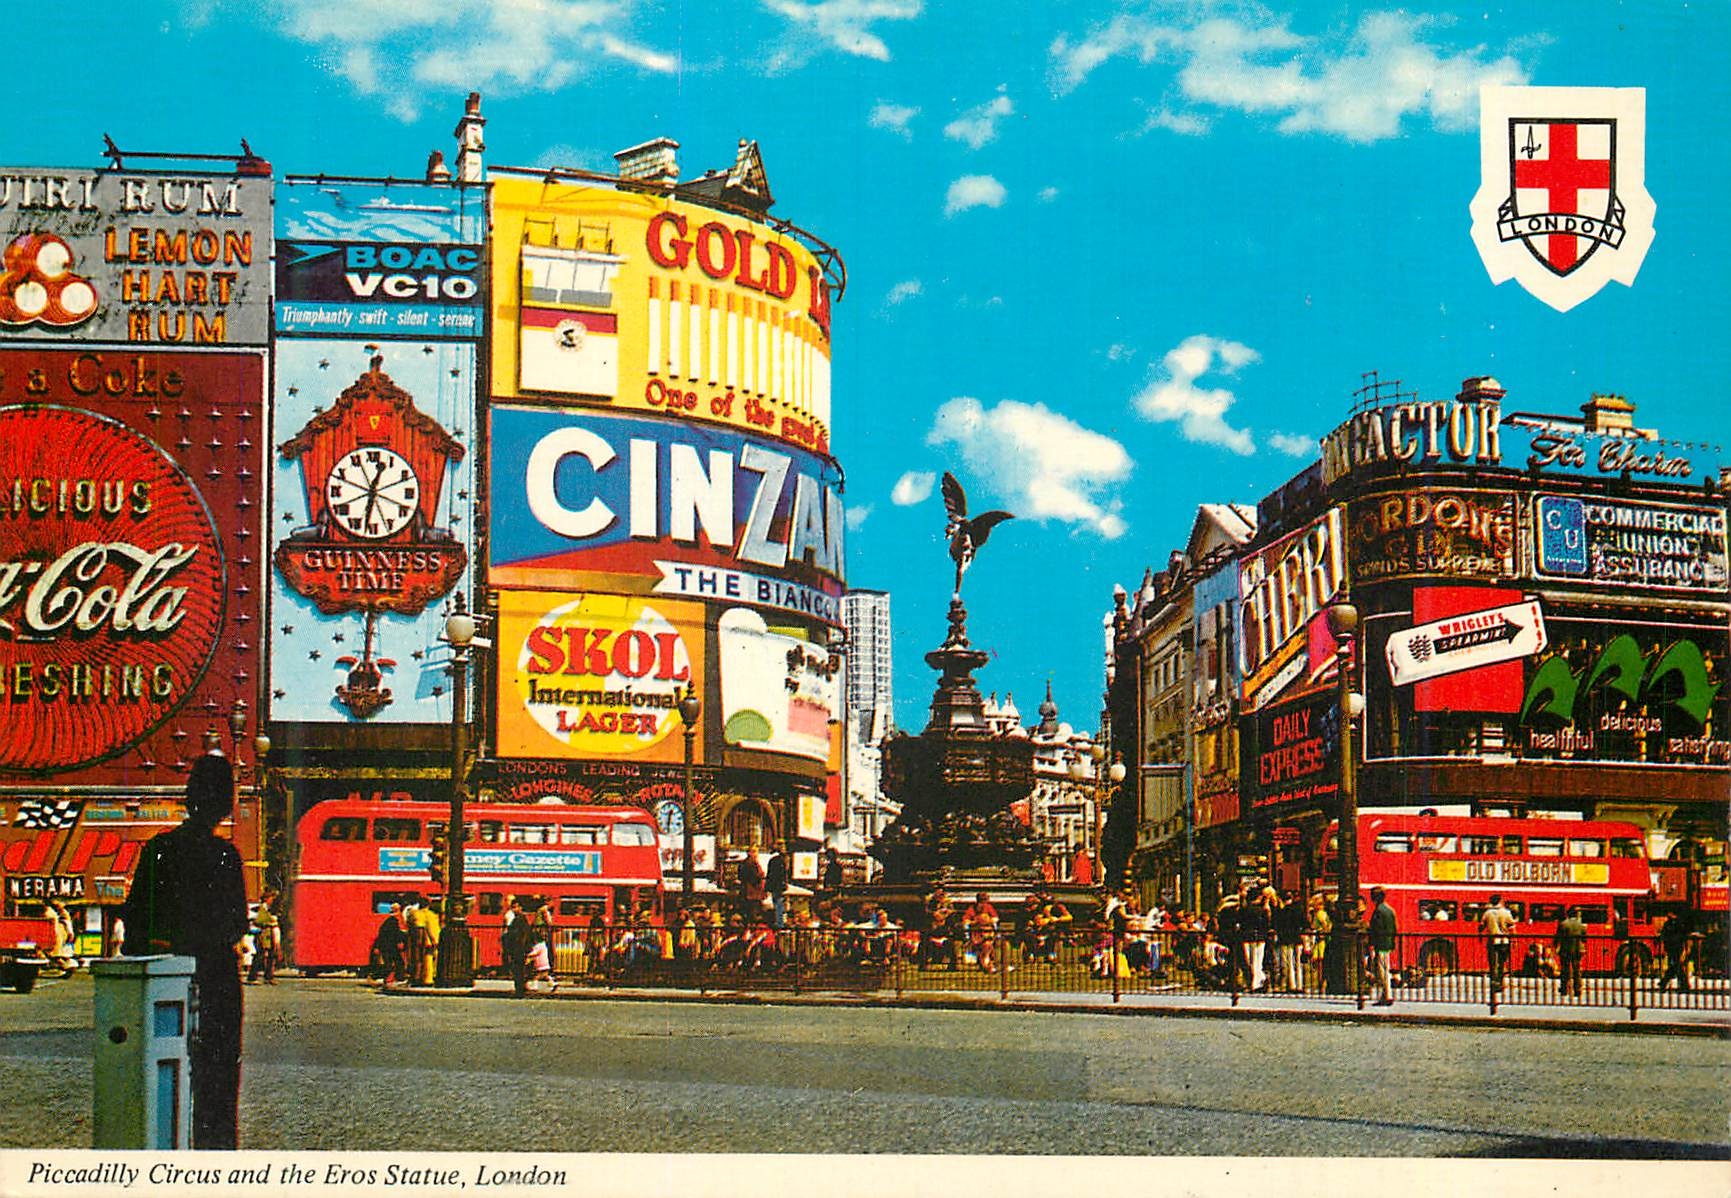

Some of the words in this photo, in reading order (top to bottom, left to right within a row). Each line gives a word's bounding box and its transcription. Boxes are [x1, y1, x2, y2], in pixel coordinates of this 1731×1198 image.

[120, 178, 242, 217] RUM
[104, 224, 252, 266] LEMON
[346, 246, 479, 271] BOAC
[646, 211, 797, 300] GOLD
[121, 269, 238, 305] HART
[345, 272, 478, 299] VC10
[127, 310, 227, 343] RUM
[282, 306, 352, 327] Triumphantly
[358, 309, 387, 325] swift
[397, 310, 428, 326] silent
[25, 369, 48, 394] a
[68, 354, 184, 397] Coke
[645, 378, 698, 411] One
[710, 392, 735, 417] of
[745, 398, 775, 428] the
[1354, 399, 1502, 468] FACTOR
[1531, 434, 1586, 467] For
[1598, 440, 1693, 476] Charm
[0, 480, 152, 514] ICIOUS
[1585, 504, 1724, 536] COMMERCIAL
[1623, 530, 1693, 556] UNION
[304, 551, 442, 572] GUINNESS
[338, 570, 407, 590] TIME
[674, 567, 741, 596] THE
[526, 626, 690, 682] SKOL
[0, 662, 174, 697] ESHING
[528, 678, 680, 710] International
[557, 710, 659, 735] LAGER
[1273, 706, 1312, 746] DAILY
[1600, 712, 1663, 732] delicious
[582, 764, 641, 777] LEADING
[1467, 861, 1497, 881] OLD
[1501, 862, 1572, 882] HOLBORN
